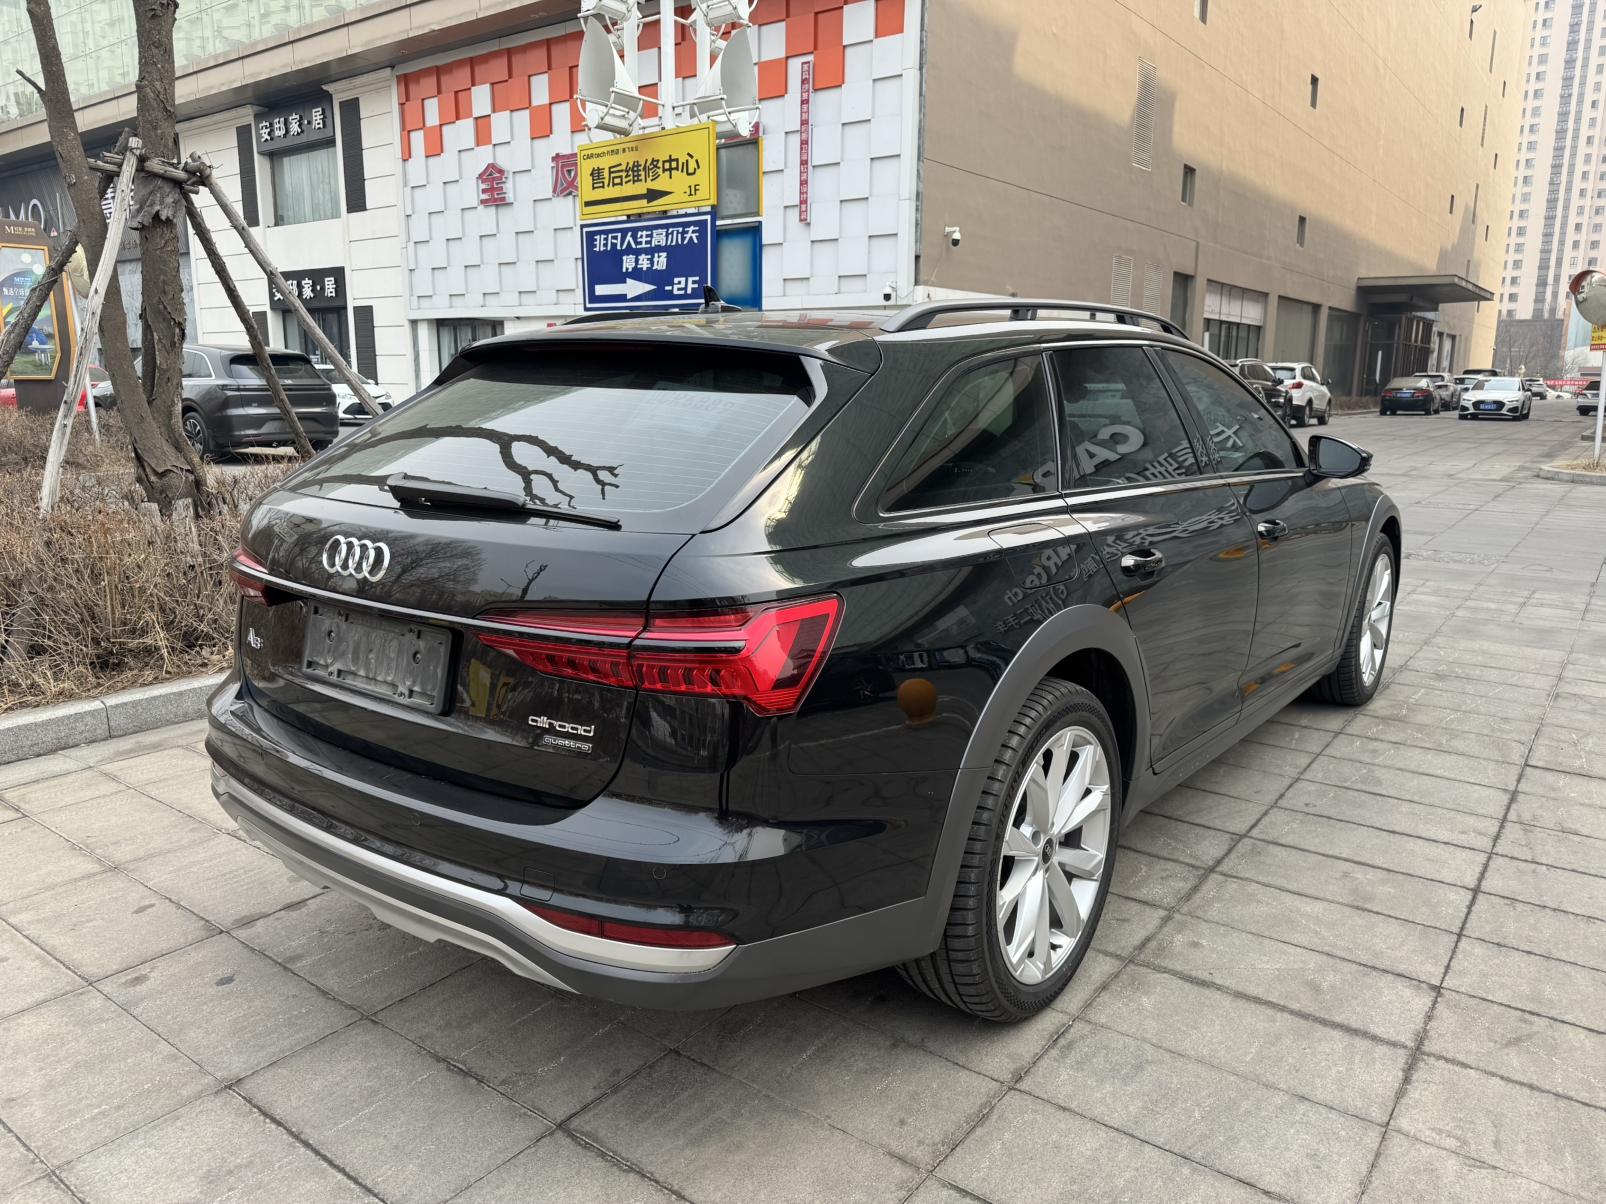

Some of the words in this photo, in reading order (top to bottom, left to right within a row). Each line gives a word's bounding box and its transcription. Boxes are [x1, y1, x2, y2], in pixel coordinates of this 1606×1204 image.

[259, 107, 324, 142] 安邸家·居
[590, 152, 700, 191] 售后维修中心
[683, 184, 701, 197] -1F
[593, 226, 700, 252] 非凡人生高尔夫
[622, 252, 668, 273] 停车场
[664, 276, 700, 295] -2F
[528, 715, 595, 737] allroad
[543, 736, 591, 752] quattro
